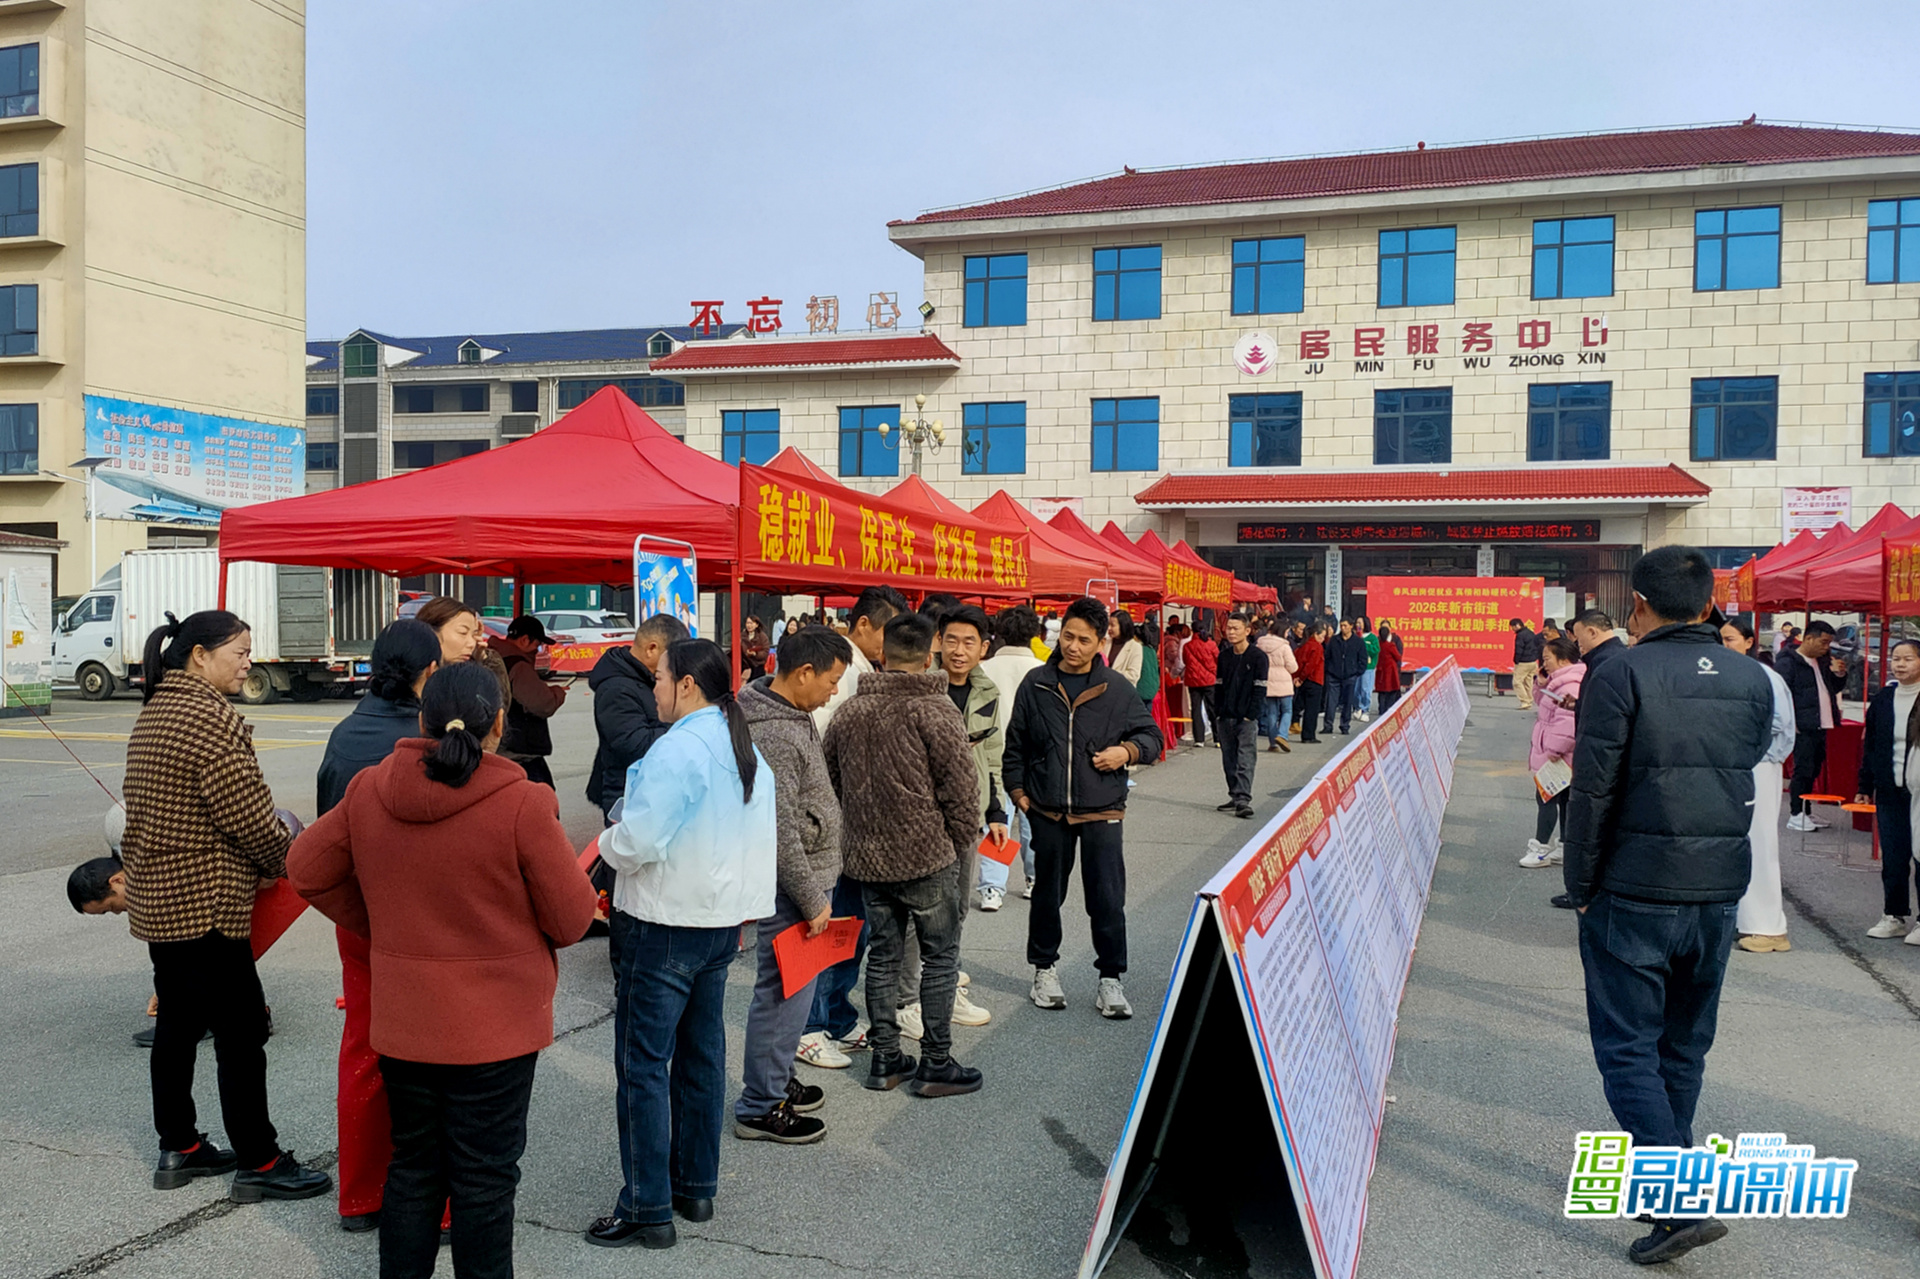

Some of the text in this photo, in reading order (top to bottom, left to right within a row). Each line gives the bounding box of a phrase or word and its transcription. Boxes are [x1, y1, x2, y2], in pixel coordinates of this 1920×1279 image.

[689, 291, 901, 335] 不忘初心
[1300, 316, 1608, 360] 居民服务中心
[1304, 352, 1606, 375] JU MIN FU WU ZHONG XIN
[1409, 602, 1499, 615] 2026年新市街道
[1374, 616, 1536, 632] 春风行动暨就业援助季招会
